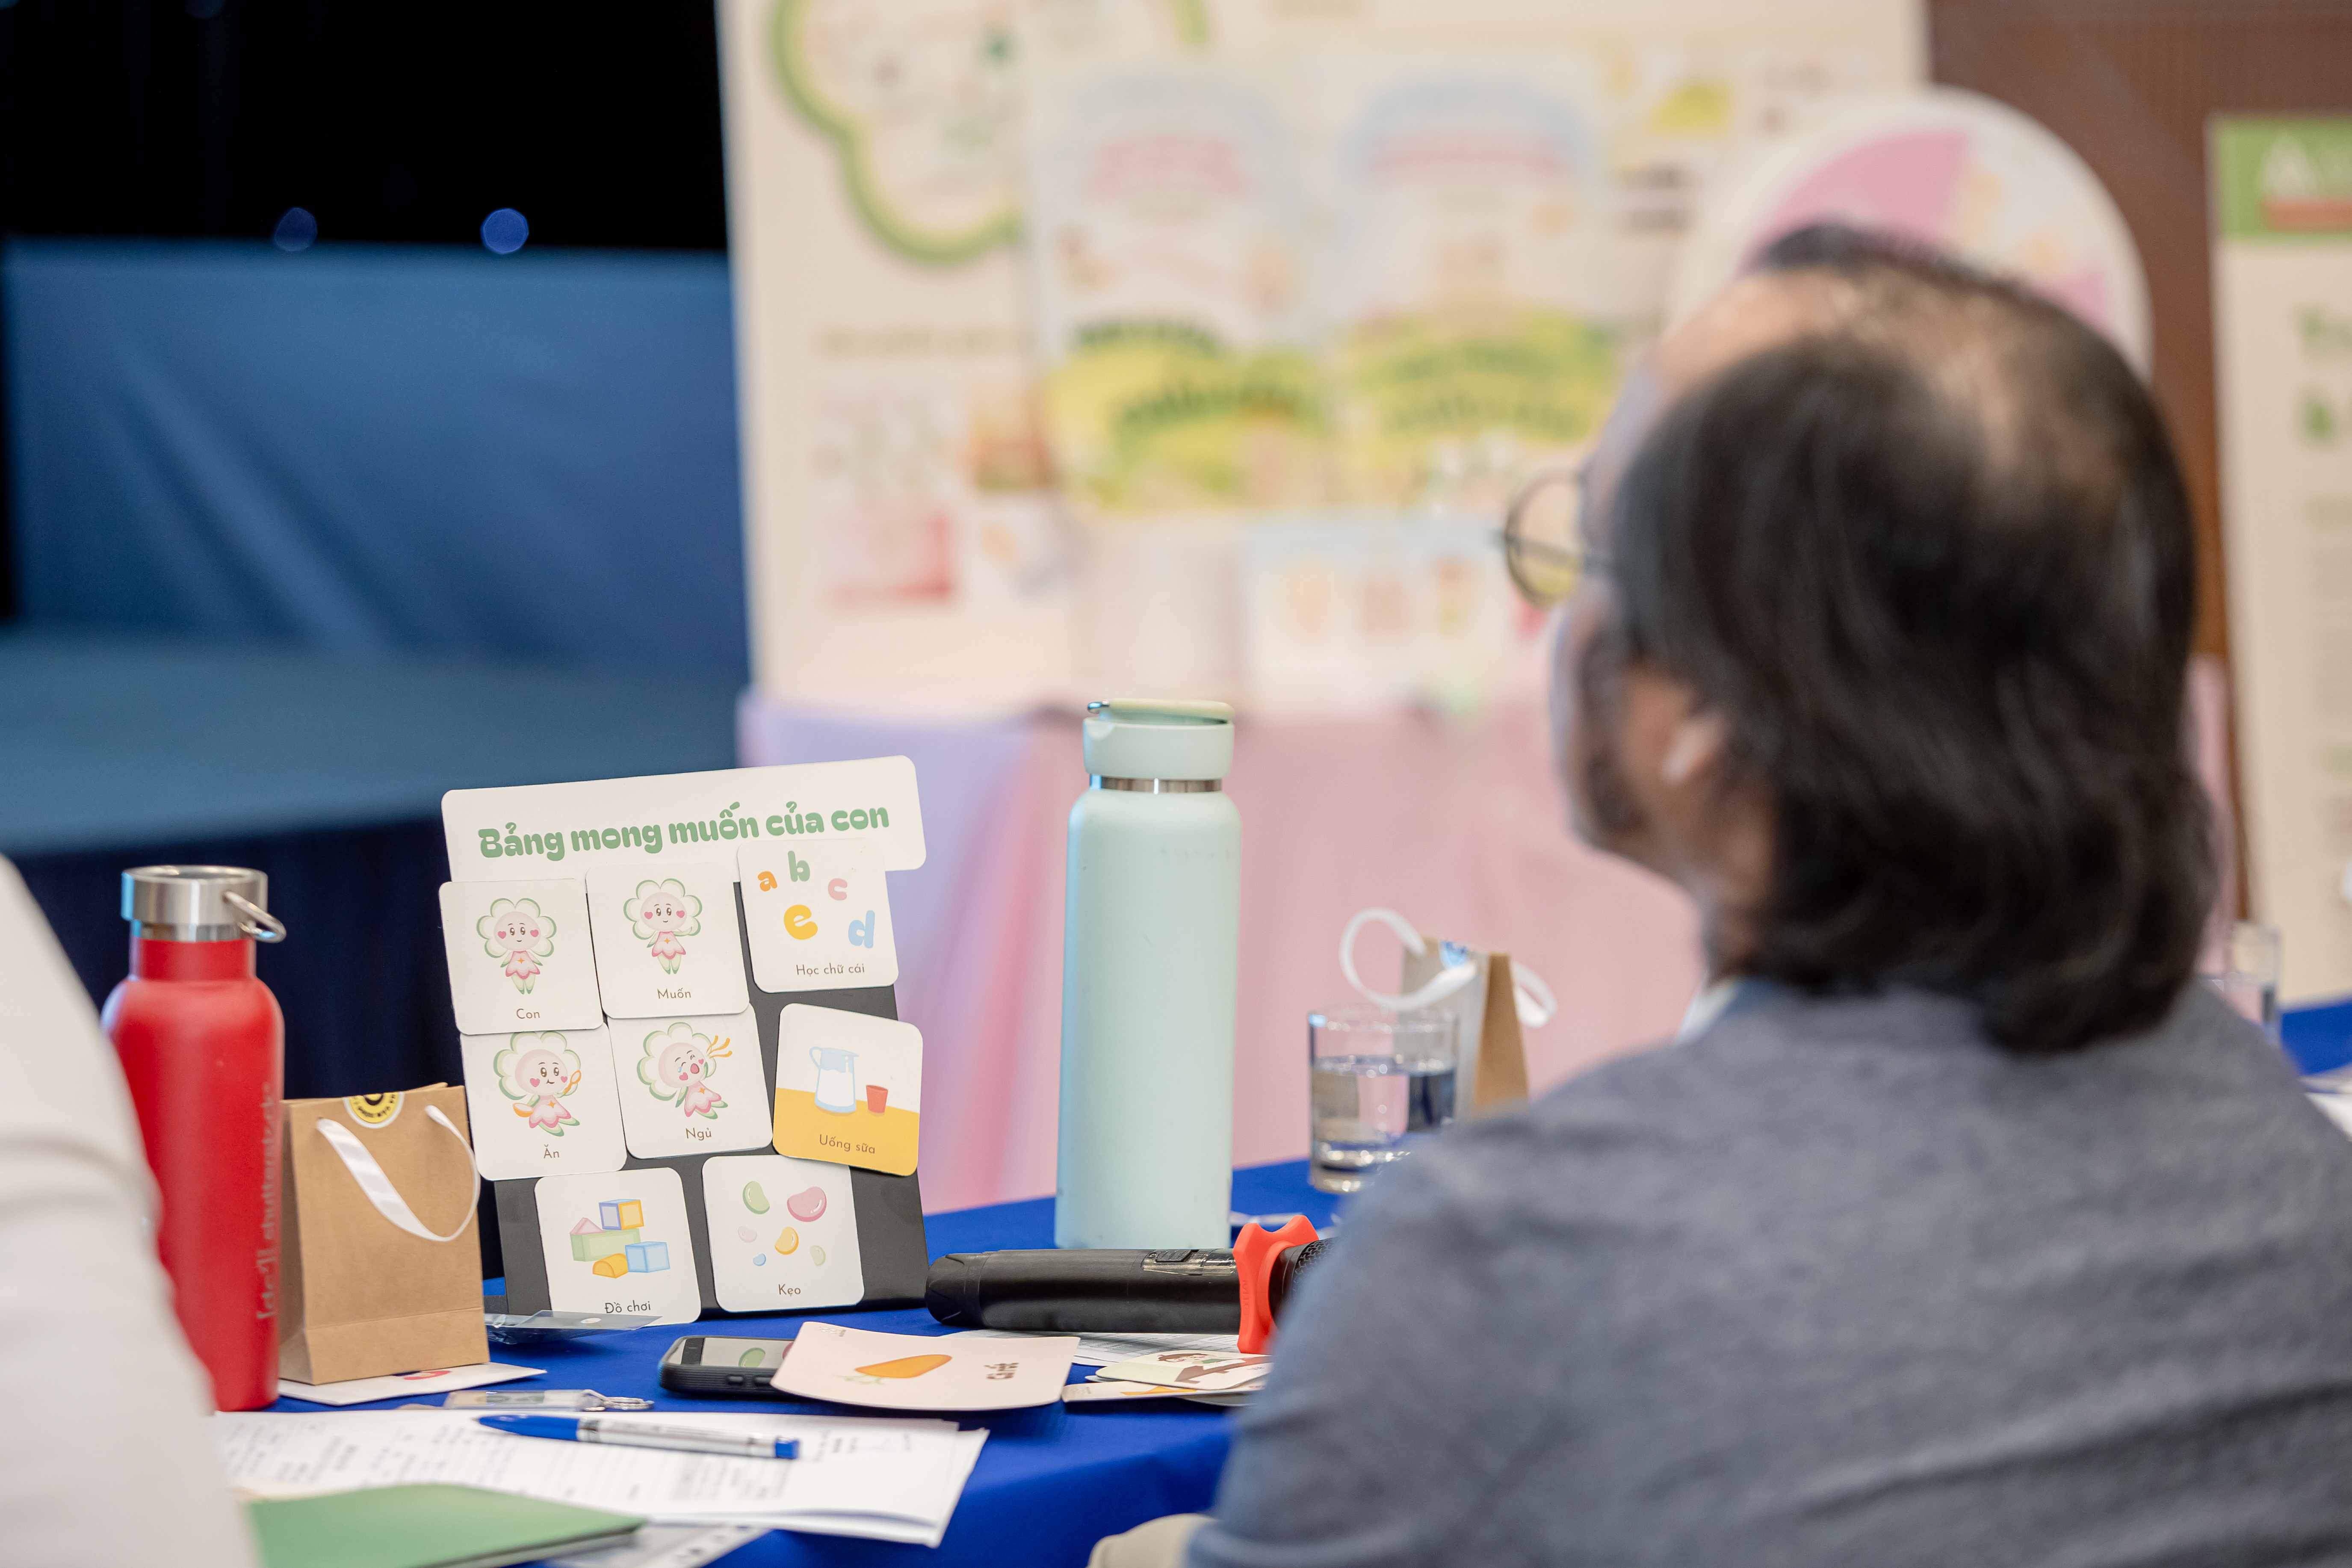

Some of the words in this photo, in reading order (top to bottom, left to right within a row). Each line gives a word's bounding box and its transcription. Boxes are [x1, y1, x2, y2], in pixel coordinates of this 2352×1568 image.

[478, 822, 565, 862] Bảng
[570, 824, 663, 854] mong
[668, 801, 759, 845] muốn
[765, 801, 825, 836] của
[831, 807, 889, 832] con
[787, 850, 810, 883] b
[757, 871, 778, 892] a
[827, 878, 848, 901] c
[783, 904, 818, 940] e
[848, 910, 875, 949] d
[796, 964, 819, 977] Học
[824, 962, 844, 974] chữ
[848, 963, 865, 974] cái
[657, 987, 691, 999] Muốn
[516, 1008, 540, 1019] Con
[686, 1127, 712, 1141] Ngủ
[544, 1143, 560, 1159] Ăn
[819, 1134, 851, 1152] Uống
[856, 1143, 876, 1154] sữa
[778, 1284, 801, 1296] Kẹo
[604, 1302, 622, 1314] Đồ
[627, 1299, 651, 1312] chơi
